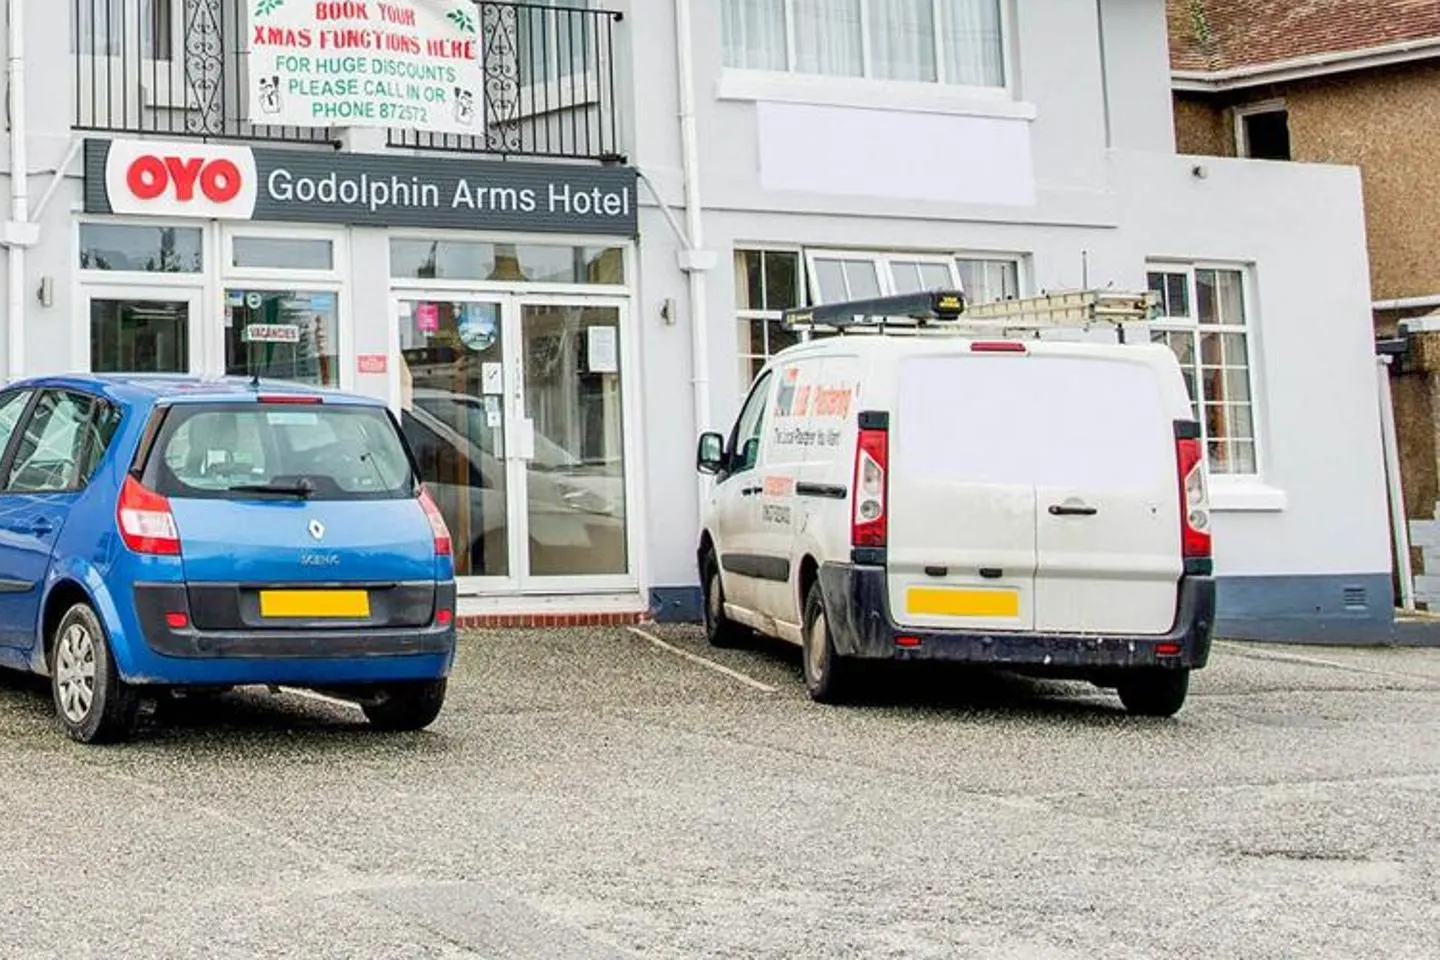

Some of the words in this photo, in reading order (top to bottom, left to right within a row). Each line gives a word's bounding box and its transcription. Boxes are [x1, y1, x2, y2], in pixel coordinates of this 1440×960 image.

[315, 0, 369, 21] BOOK
[377, 2, 416, 27] YOUR
[253, 25, 312, 48] XMAS
[319, 29, 421, 56] FUNCTIONS
[426, 38, 478, 60] HERE
[275, 55, 310, 73] FOR
[315, 57, 368, 74] HUGE
[372, 59, 457, 83] DISCOUNTS
[288, 78, 359, 96] PLEASE
[363, 80, 403, 98] CALL
[405, 85, 420, 100] IN
[424, 87, 446, 103] OR
[312, 101, 375, 118] PHONE
[379, 103, 429, 122] 872572
[126, 155, 242, 203] OYO
[268, 169, 439, 211] Godolphin
[451, 178, 536, 212] Arms
[547, 183, 629, 216] Hotel
